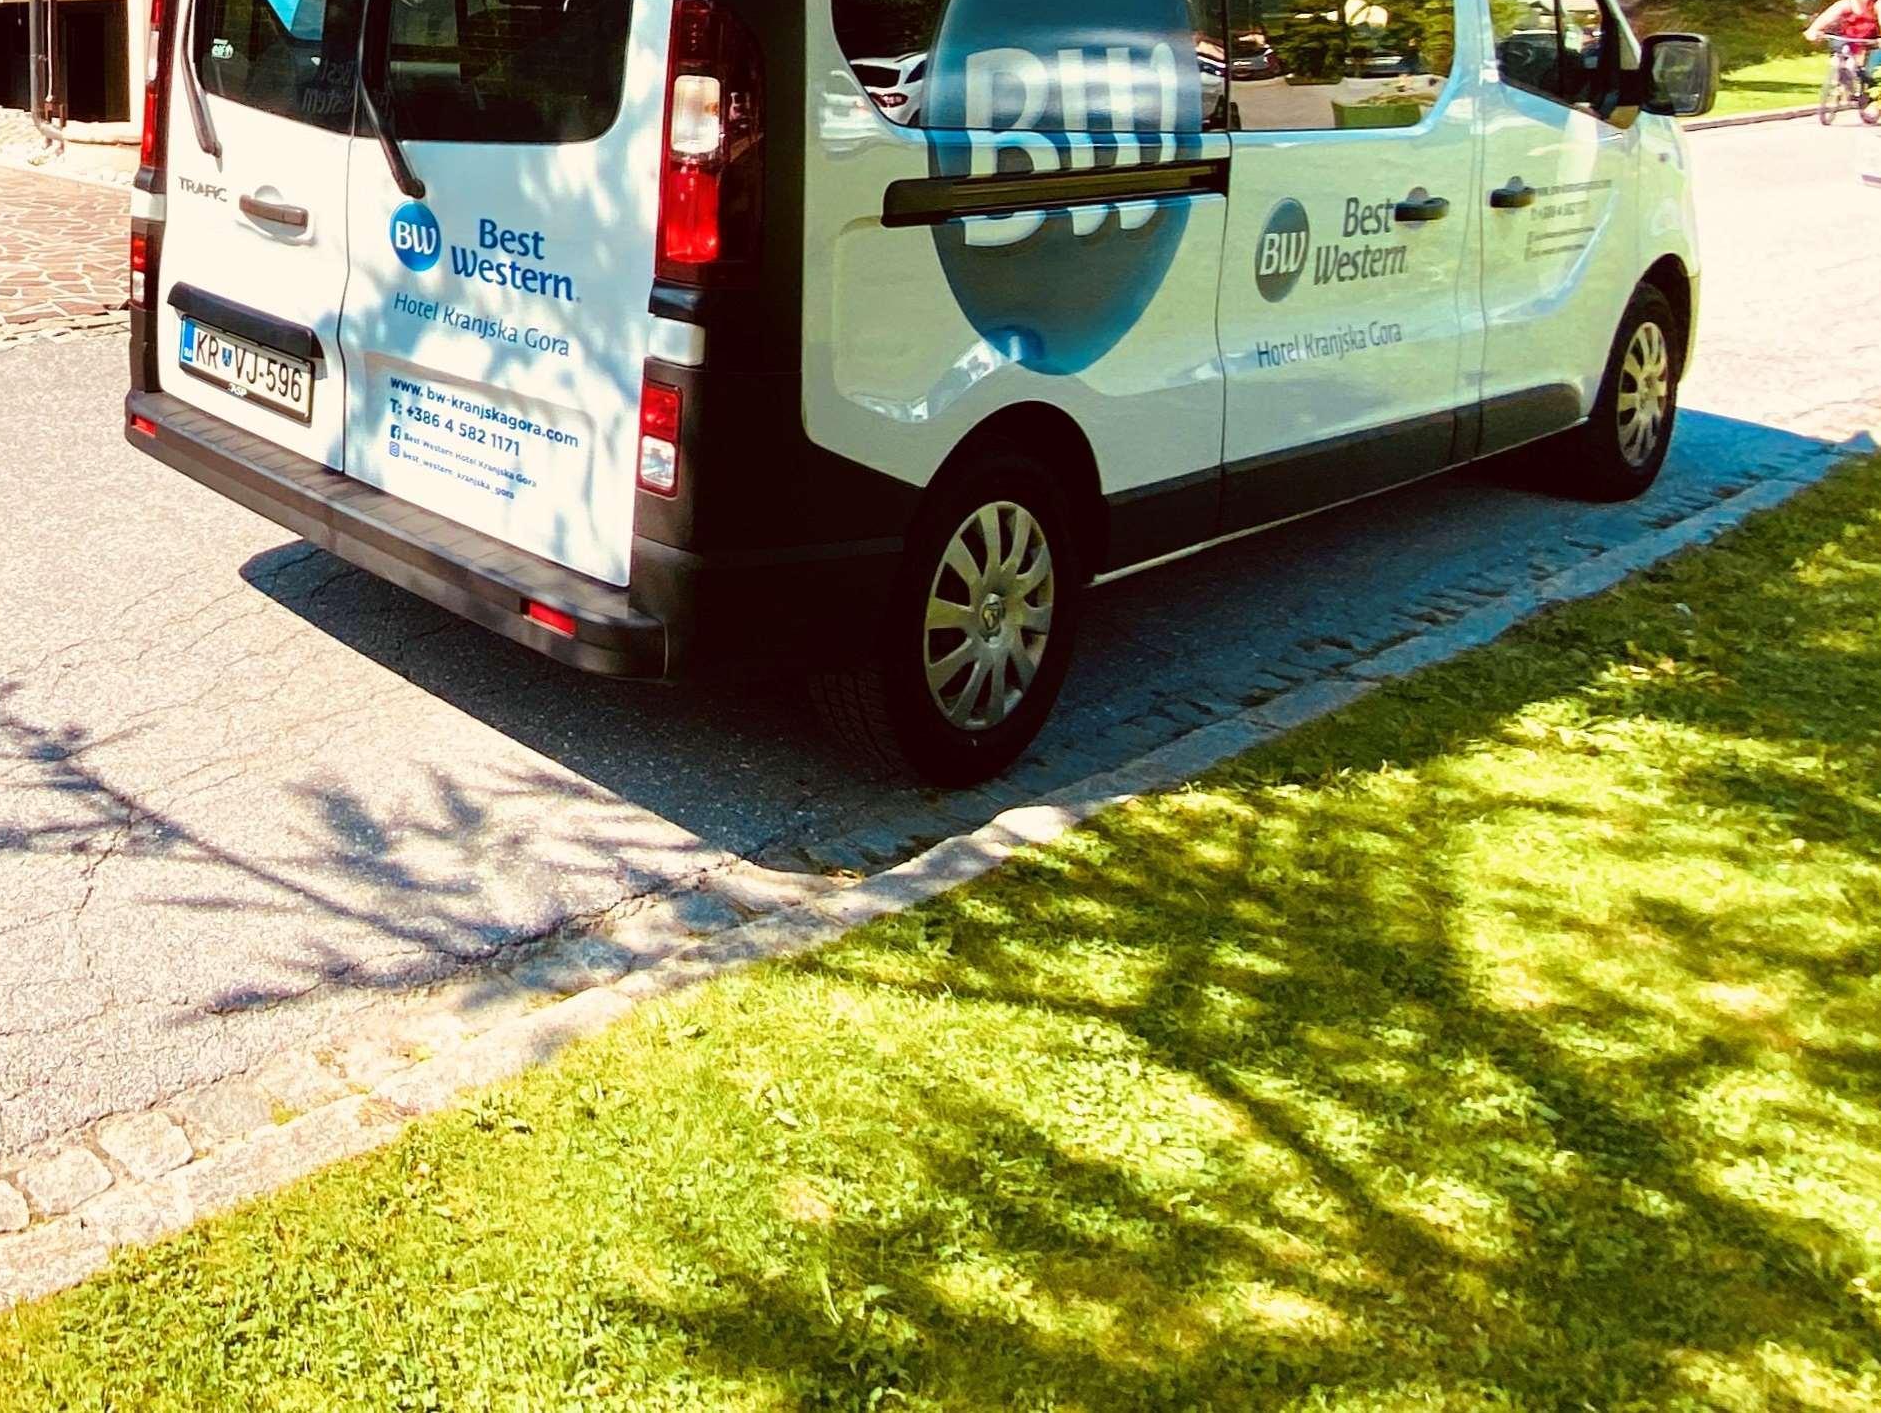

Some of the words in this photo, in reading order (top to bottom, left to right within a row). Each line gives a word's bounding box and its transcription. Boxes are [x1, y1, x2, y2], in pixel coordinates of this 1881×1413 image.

[178, 176, 228, 202] TRAFIC
[395, 220, 437, 255] BW
[1342, 196, 1395, 238] Best
[479, 218, 545, 260] Best
[1259, 230, 1306, 276] BW
[1313, 244, 1408, 286] Western
[394, 292, 439, 321] Hotel
[442, 305, 518, 343] Kranjska
[524, 327, 569, 357] Gora
[197, 332, 219, 369] KR
[235, 344, 303, 402] VJ-596
[1255, 334, 1301, 368] Hotel
[1303, 325, 1368, 361] Kranjska
[390, 398, 403, 416] T:
[406, 404, 440, 428] +386
[444, 418, 455, 433] 4
[458, 423, 487, 445] 582
[491, 433, 521, 457] 1171
